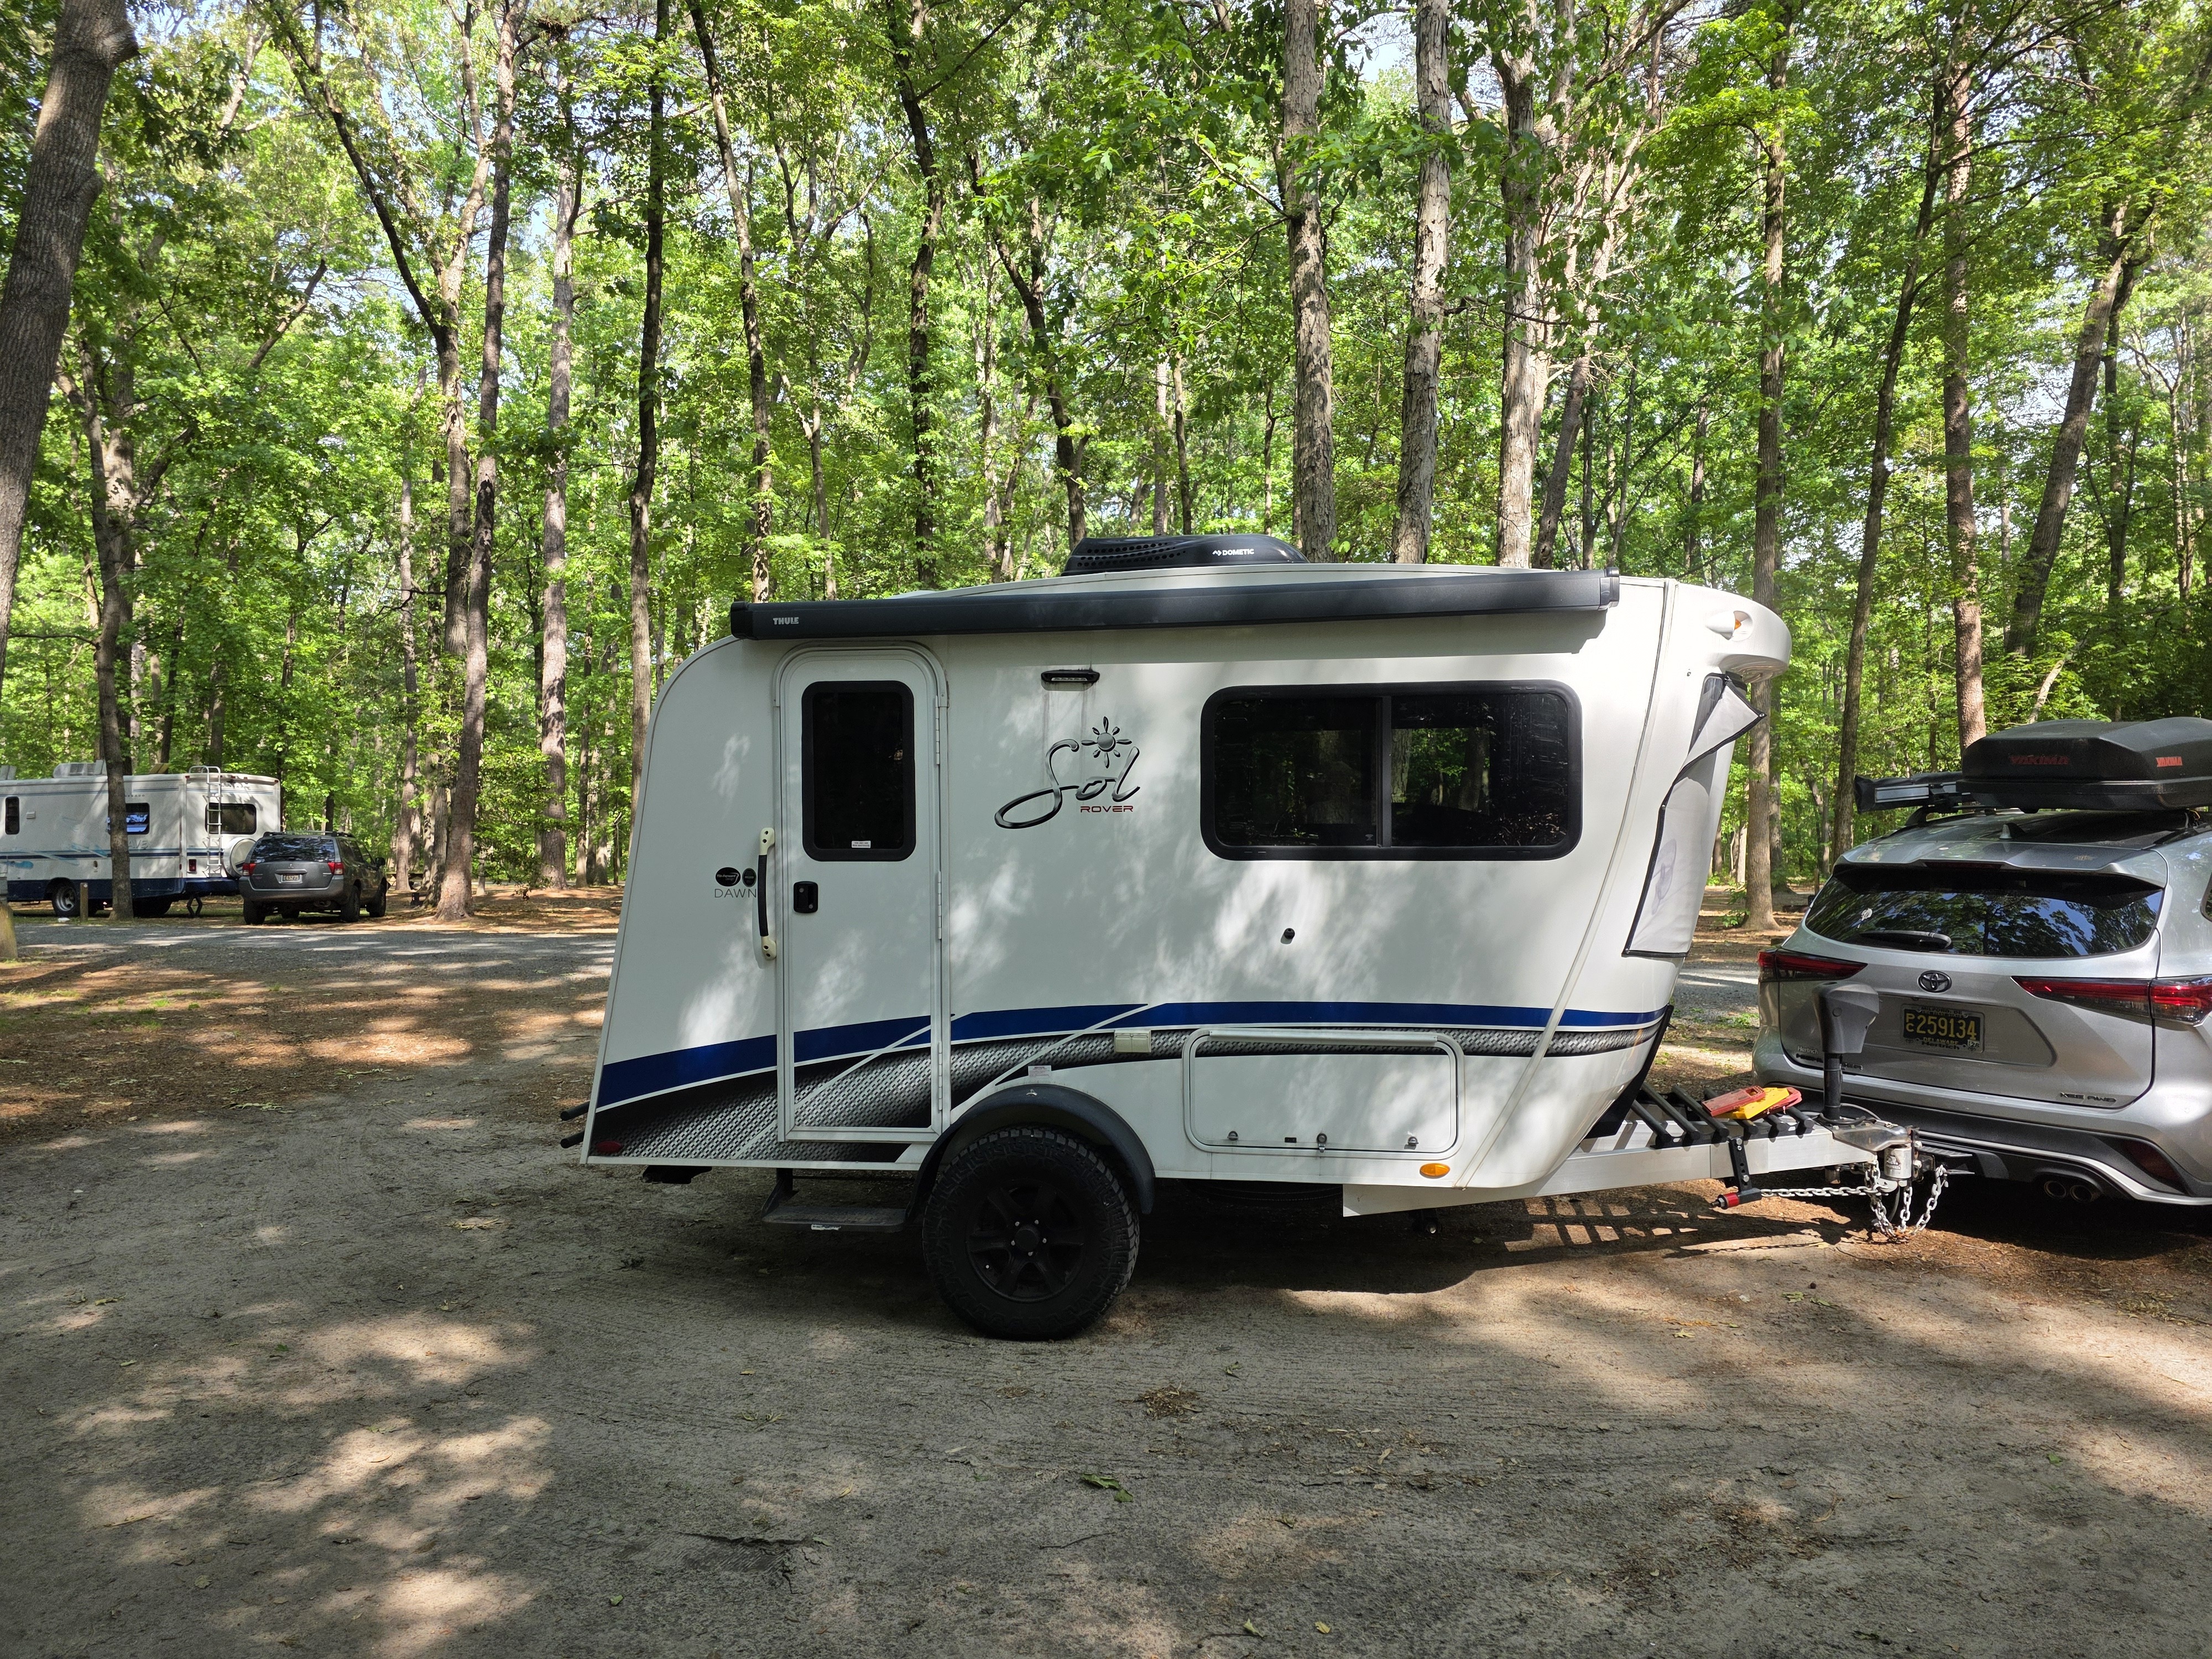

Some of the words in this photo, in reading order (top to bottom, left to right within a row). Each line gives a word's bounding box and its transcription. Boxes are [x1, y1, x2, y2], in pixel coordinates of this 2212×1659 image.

[2010, 755, 2069, 765] YAKIMA
[2156, 757, 2183, 767] YAKIMA
[994, 739, 1140, 829] Sol
[714, 888, 757, 898] DAWN
[1916, 1015, 1977, 1040] 259134
[1921, 1041, 1960, 1050] Hertrich
[1923, 1037, 1959, 1045] DELAWARE
[1797, 1046, 1818, 1054] Hertrich
